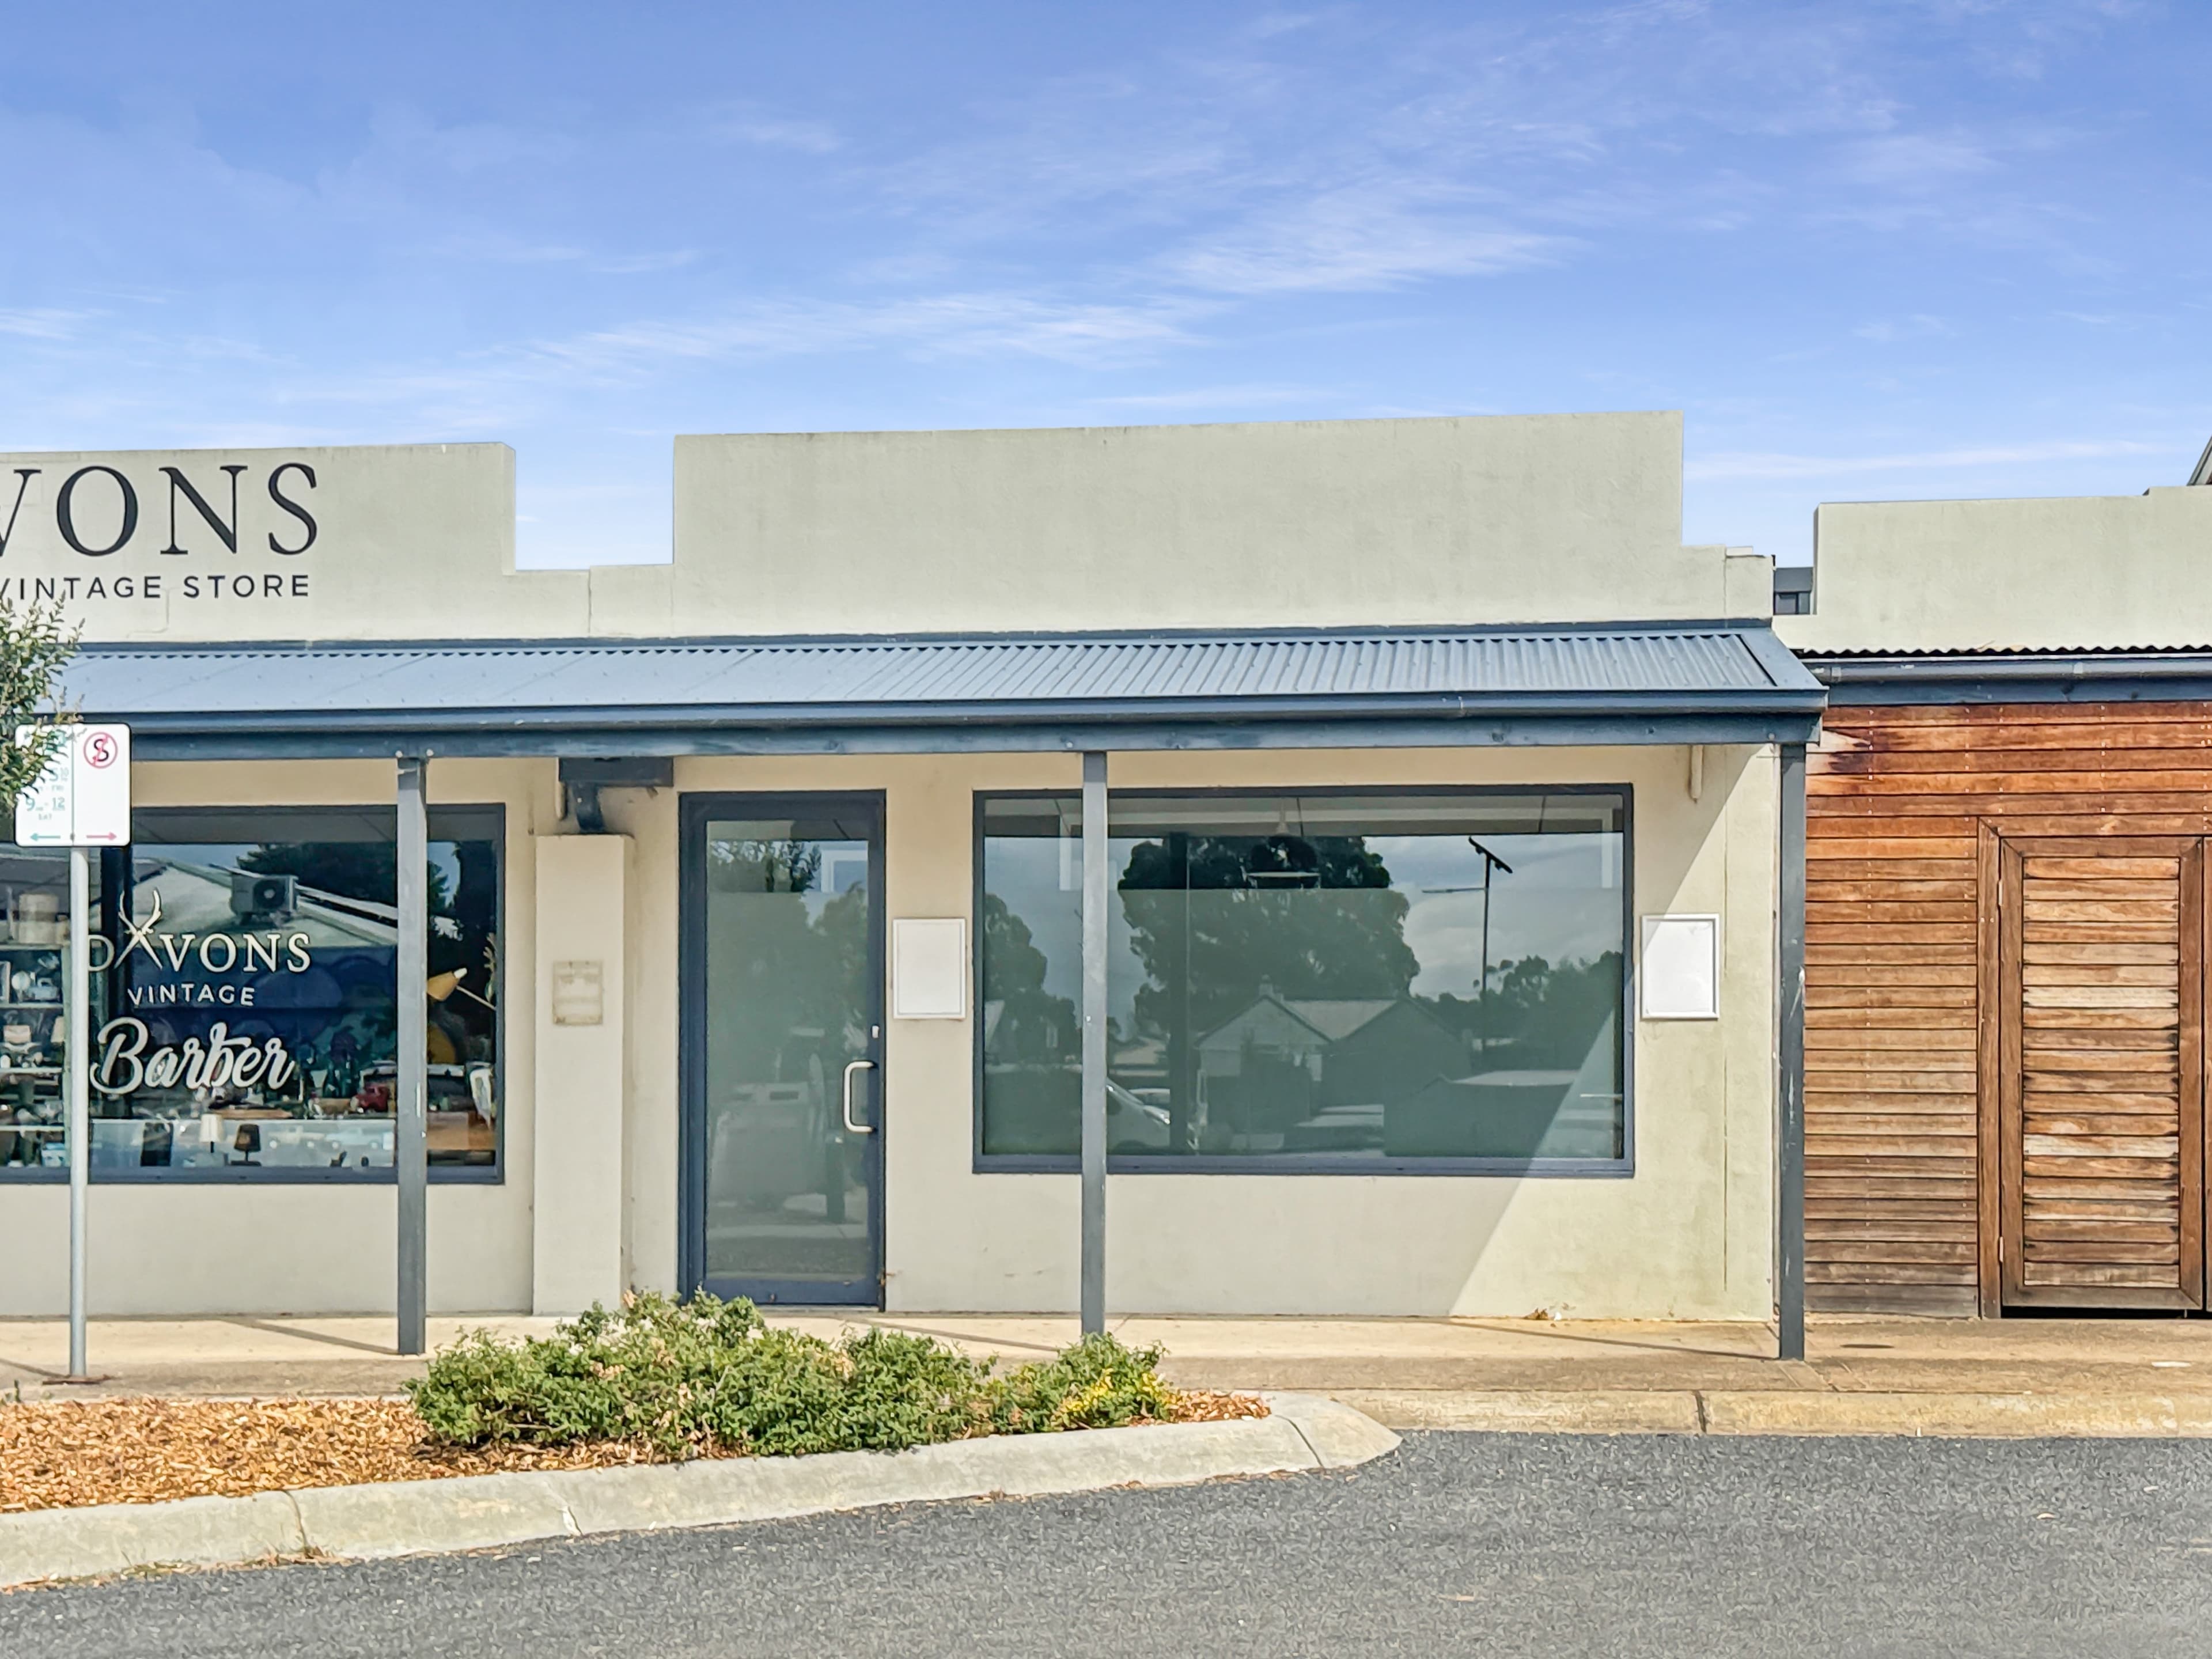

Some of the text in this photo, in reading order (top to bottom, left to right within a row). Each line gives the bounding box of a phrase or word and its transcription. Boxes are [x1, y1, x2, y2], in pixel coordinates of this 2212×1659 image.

[183, 574, 309, 599] STORE
[127, 984, 255, 1006] VINTAGE
[90, 1017, 294, 1094] Barber
